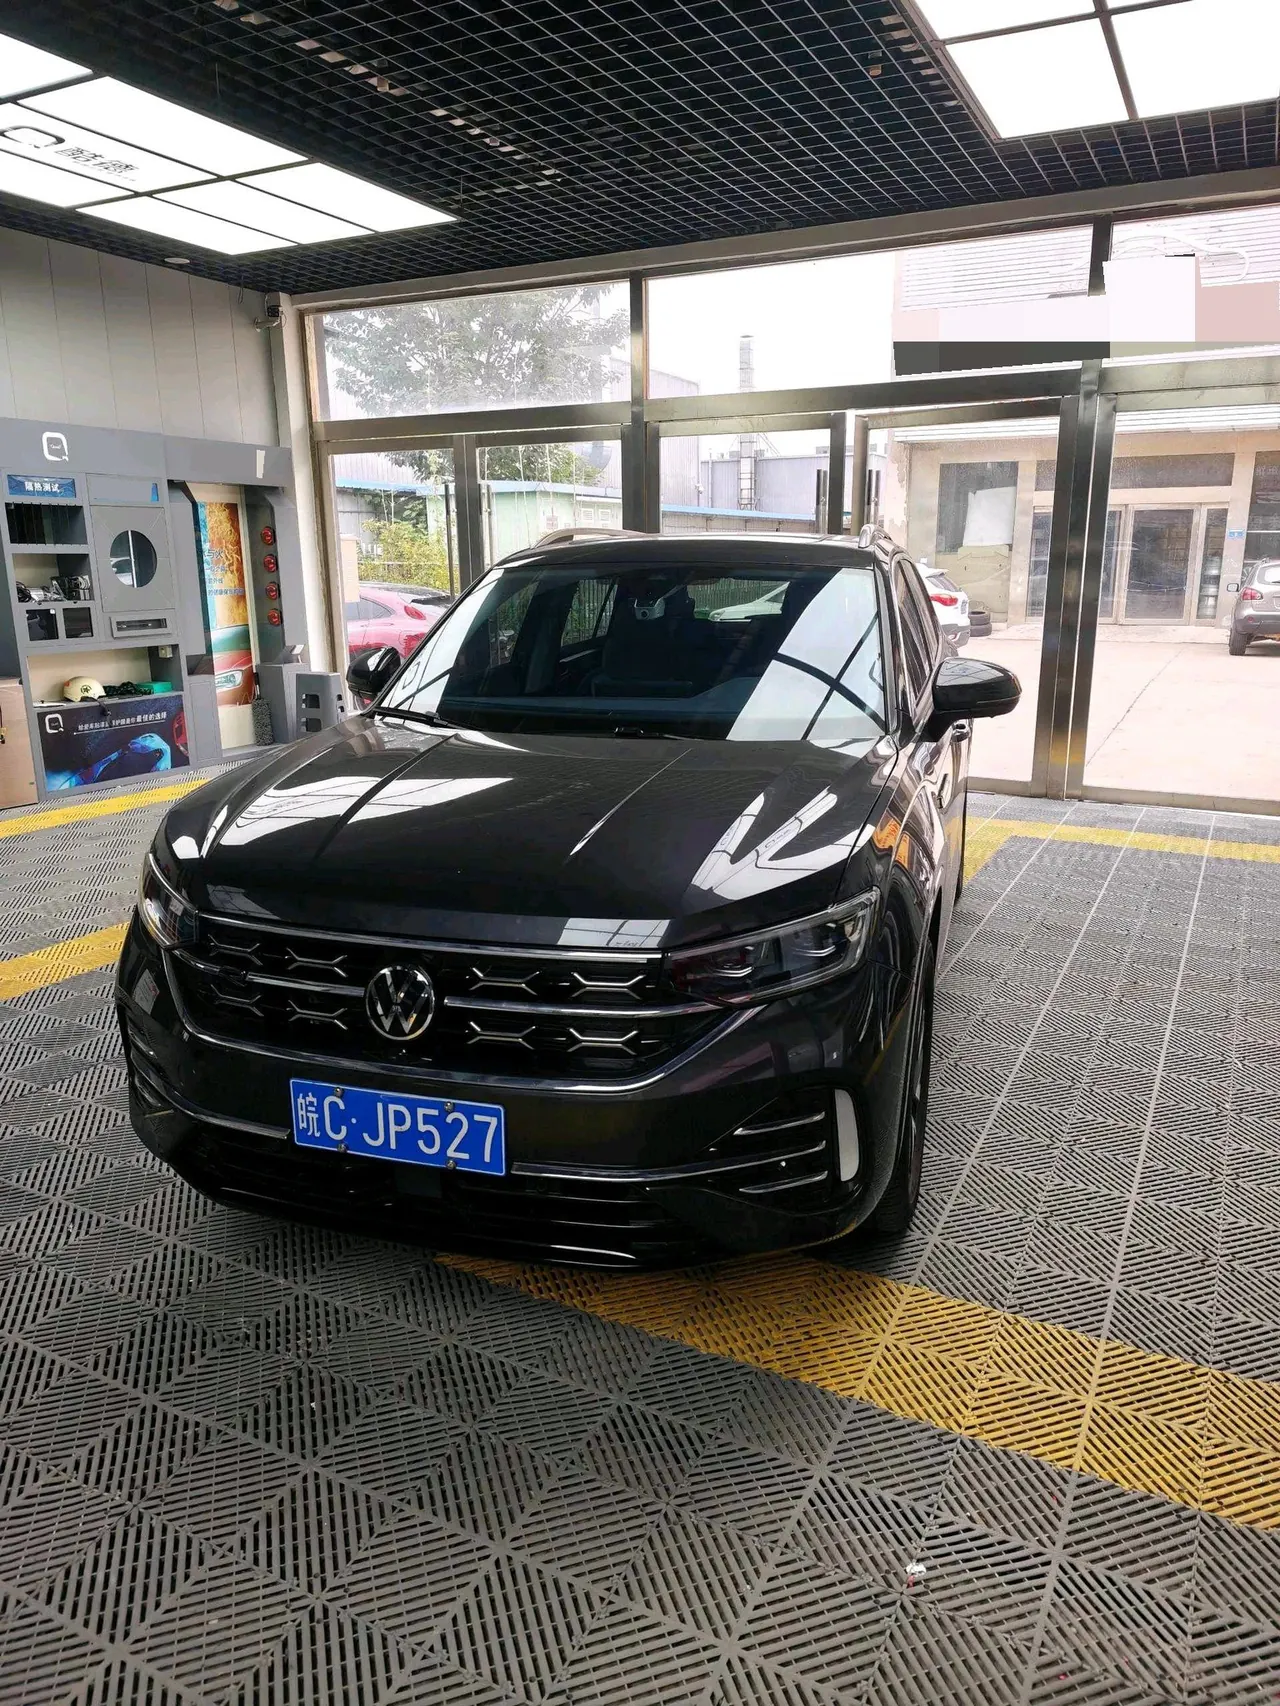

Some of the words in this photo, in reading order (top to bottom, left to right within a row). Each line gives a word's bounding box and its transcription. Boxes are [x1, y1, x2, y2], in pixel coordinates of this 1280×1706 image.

[24, 481, 60, 493] 隔热测试
[296, 1091, 499, 1164] 皖C·JP527
